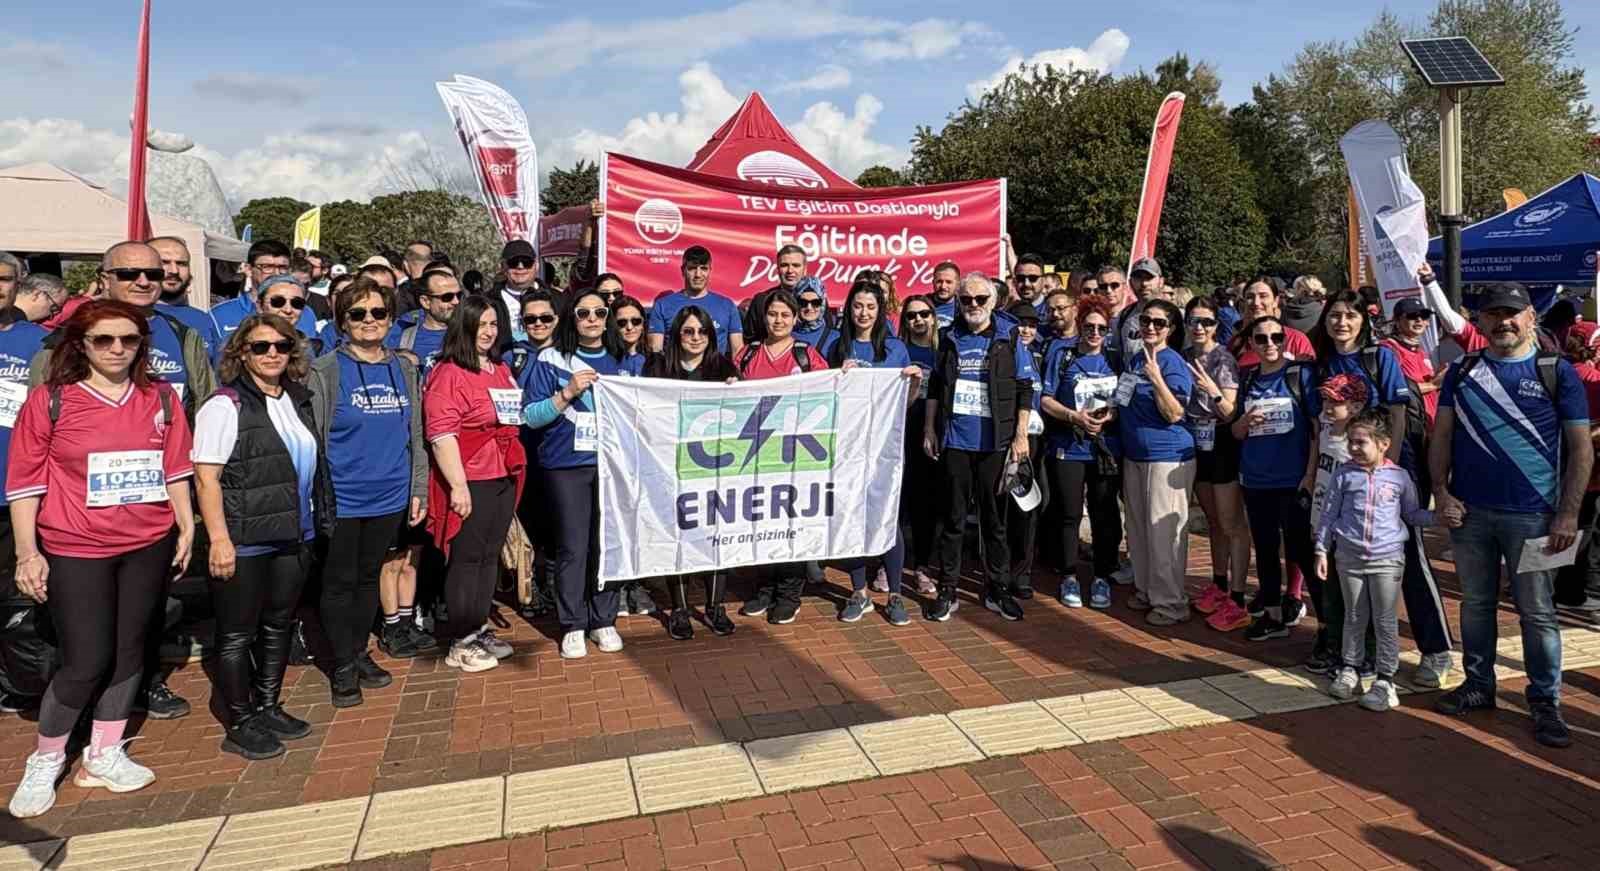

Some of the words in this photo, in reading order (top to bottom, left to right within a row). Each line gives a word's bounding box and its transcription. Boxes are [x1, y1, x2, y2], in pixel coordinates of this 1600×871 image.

[751, 176, 818, 188] TEV
[737, 195, 777, 210] TEV
[785, 199, 850, 215] Eğitim
[854, 201, 959, 219] Dostlarıyla
[641, 222, 678, 234] TEV
[775, 224, 928, 262] Eğitimde
[740, 256, 780, 288] Du
[96, 471, 160, 486] 10450
[737, 533, 754, 544] an
